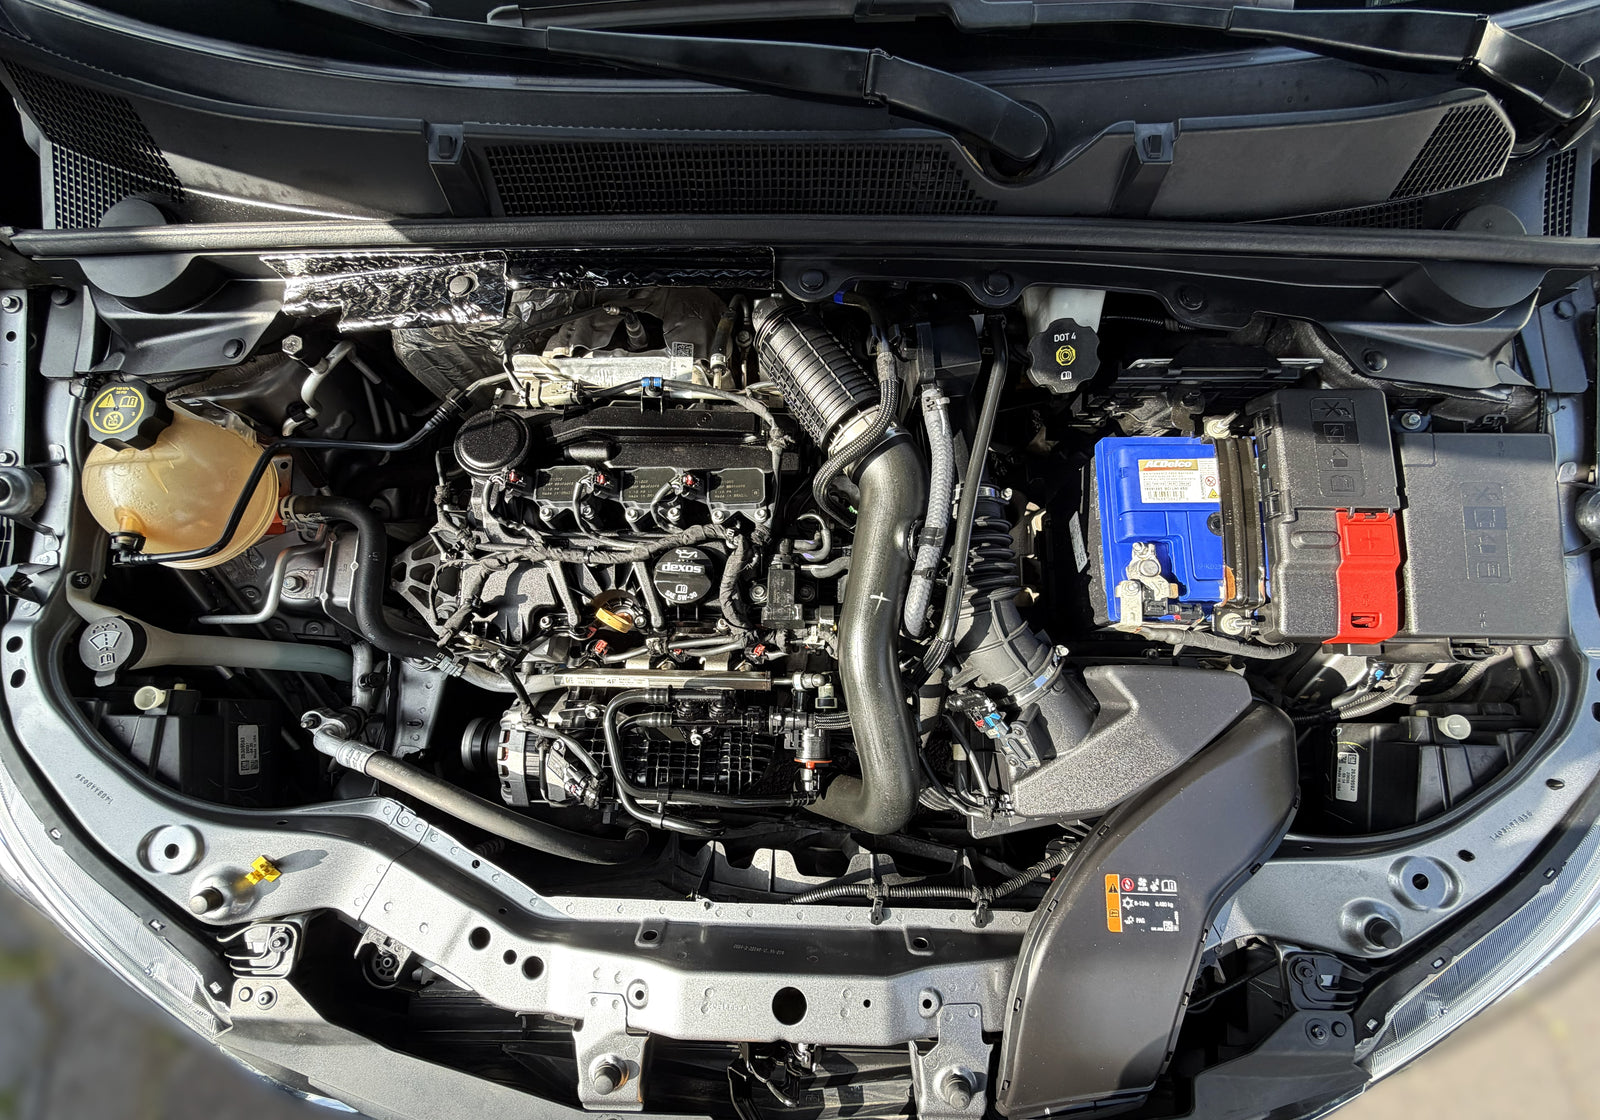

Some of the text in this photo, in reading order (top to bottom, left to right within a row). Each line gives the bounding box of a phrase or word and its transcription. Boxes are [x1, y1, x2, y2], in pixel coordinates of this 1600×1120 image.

[1053, 332, 1077, 342] DOT 4
[1144, 459, 1193, 468] ACDelco
[661, 561, 703, 573] dexos
[664, 590, 698, 601] SAE 5W-30
